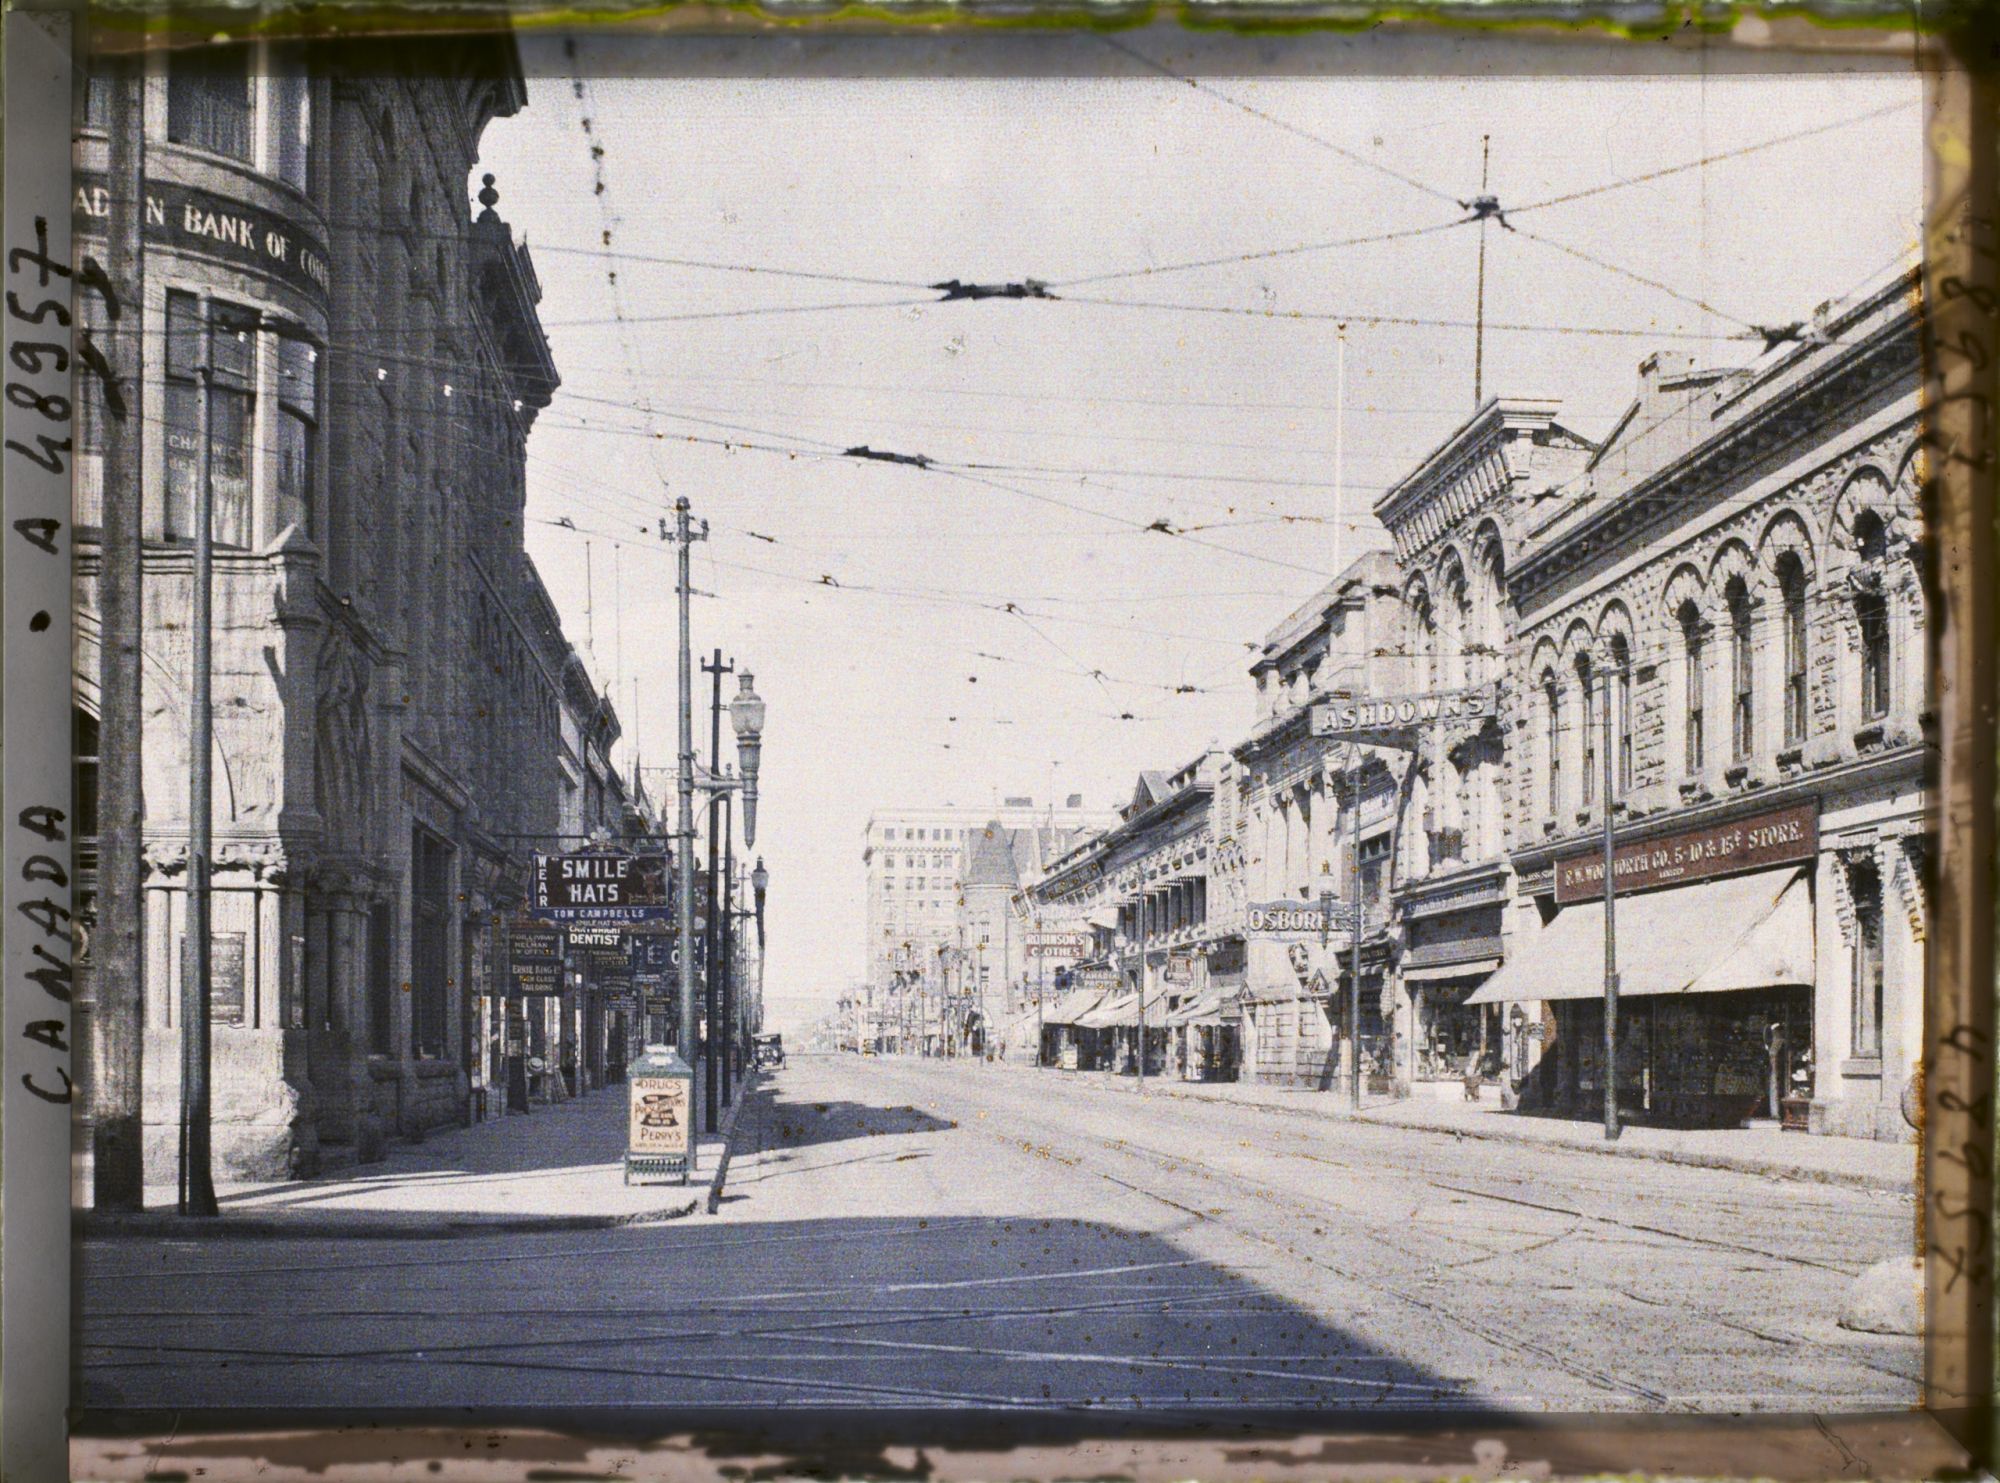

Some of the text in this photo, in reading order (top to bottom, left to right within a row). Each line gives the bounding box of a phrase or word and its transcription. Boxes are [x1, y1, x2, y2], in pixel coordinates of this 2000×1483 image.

[78, 187, 165, 226] ADN
[184, 203, 256, 250] BANK
[266, 231, 290, 263] OF
[4, 215, 73, 1105] CANADA A 48957
[538, 856, 548, 907] WEAR
[570, 883, 619, 903] HATS
[554, 909, 575, 918] TOM
[569, 933, 620, 945] DENTIST
[1031, 947, 1080, 956] COTHES
[641, 1079, 682, 1090] DRUGS
[1932, 1025, 1990, 1294] 48957
